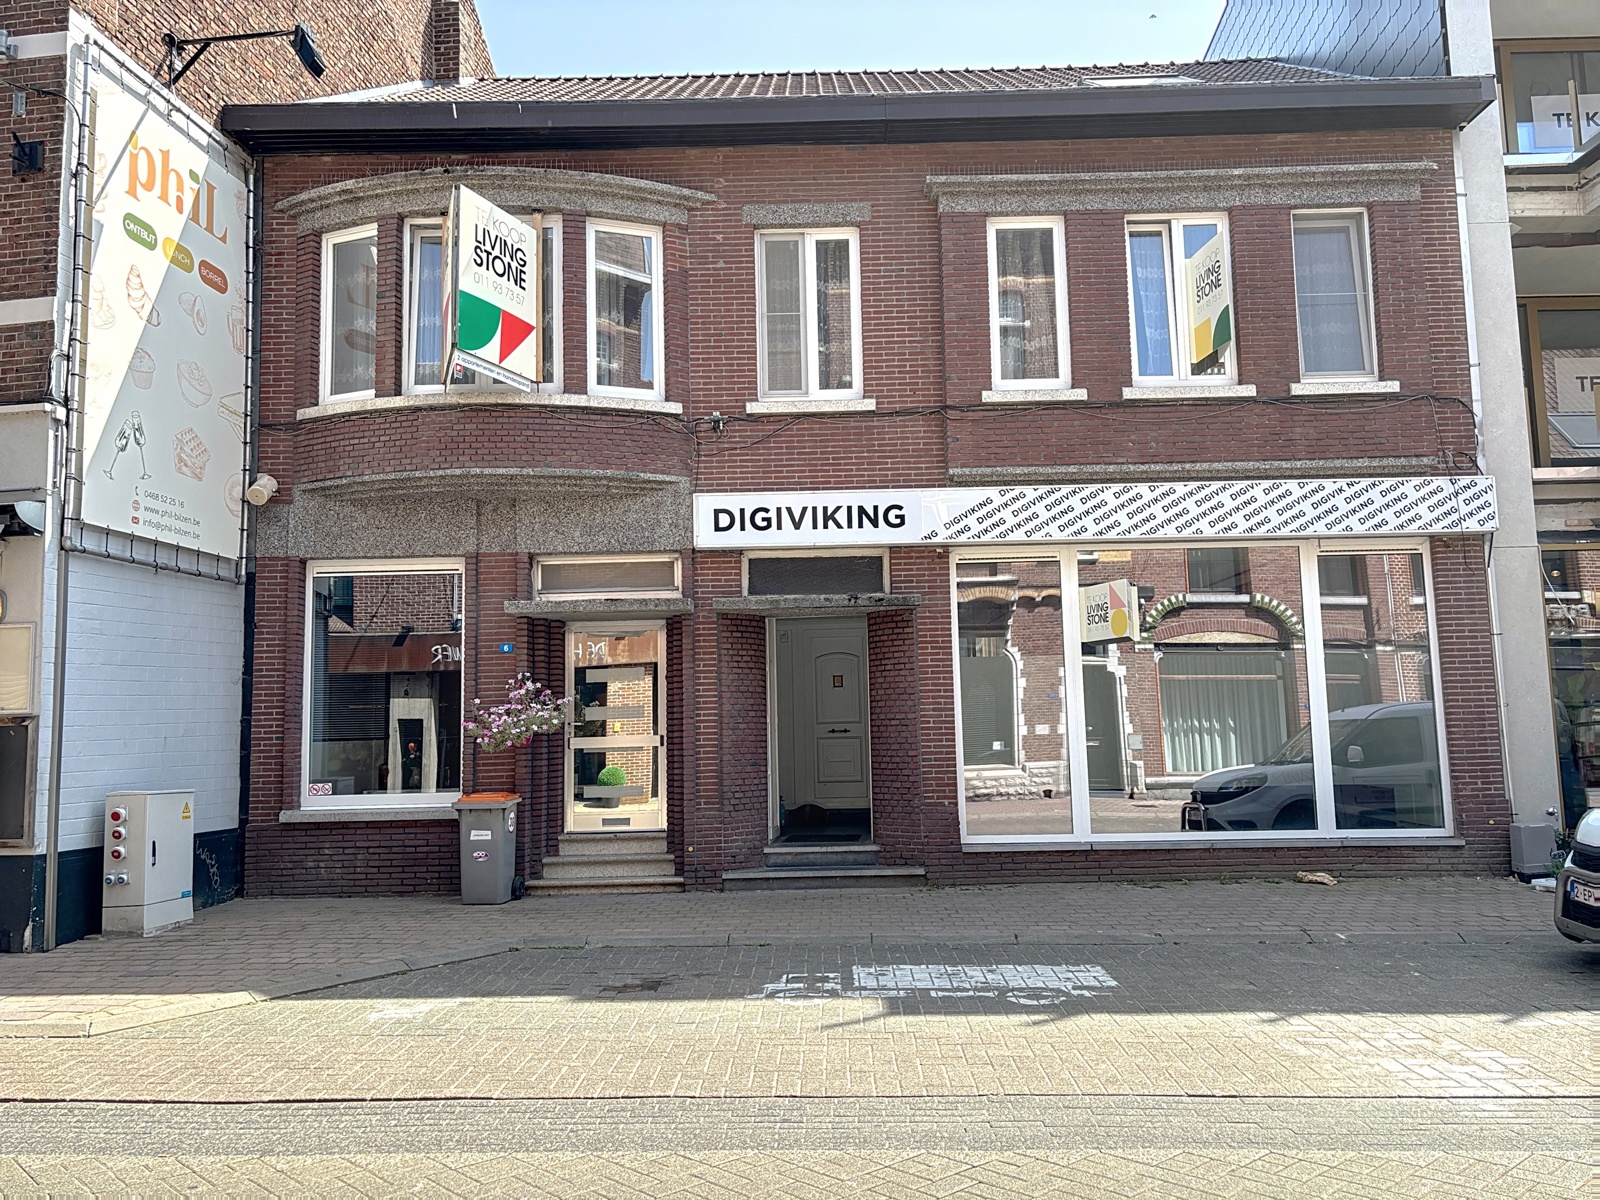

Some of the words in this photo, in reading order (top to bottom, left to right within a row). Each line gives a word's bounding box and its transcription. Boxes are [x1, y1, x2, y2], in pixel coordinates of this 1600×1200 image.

[475, 205, 488, 227] TE
[493, 216, 527, 246] KOOP
[166, 245, 190, 266] LUNCH
[475, 223, 527, 268] LIVING
[200, 266, 226, 289] BORREL
[473, 245, 527, 292] STONE
[1195, 260, 1221, 289] LIVING
[474, 271, 489, 288] 011
[492, 280, 503, 295] 93
[505, 287, 515, 301] 73
[516, 293, 526, 306] 57
[1196, 272, 1222, 304] STONE
[144, 489, 160, 502] 0468
[160, 494, 168, 504] 52
[168, 497, 177, 506] 25
[177, 499, 185, 509] 16
[976, 491, 1027, 525] DIGIVIKING
[1093, 492, 1143, 525] DIGIVIKING
[1126, 486, 1177, 520] DIGIVIKING
[1208, 495, 1258, 528] DIGIVIKING
[1243, 488, 1293, 522] DIGIVIKING
[1276, 483, 1326, 516] DIGIVIKING
[1357, 491, 1409, 525] DIGIVIKING
[1393, 485, 1444, 519] DIGIVIKING
[1427, 479, 1478, 513] DIGIVIKING
[142, 517, 201, 541] info@phil-bilzen.be
[143, 505, 201, 527] www.phil-bilzen.be
[713, 504, 906, 532] DIGIVIKING
[943, 497, 994, 530] DIGIVIKING
[1024, 504, 1075, 538] DIGIVIKING
[1057, 499, 1108, 532] DIGIVIKING
[1175, 500, 1225, 534] DIGIVIKING
[1324, 497, 1375, 531] DIGIVIKING
[1086, 601, 1109, 615] LIVING
[1087, 612, 1109, 625] STONE
